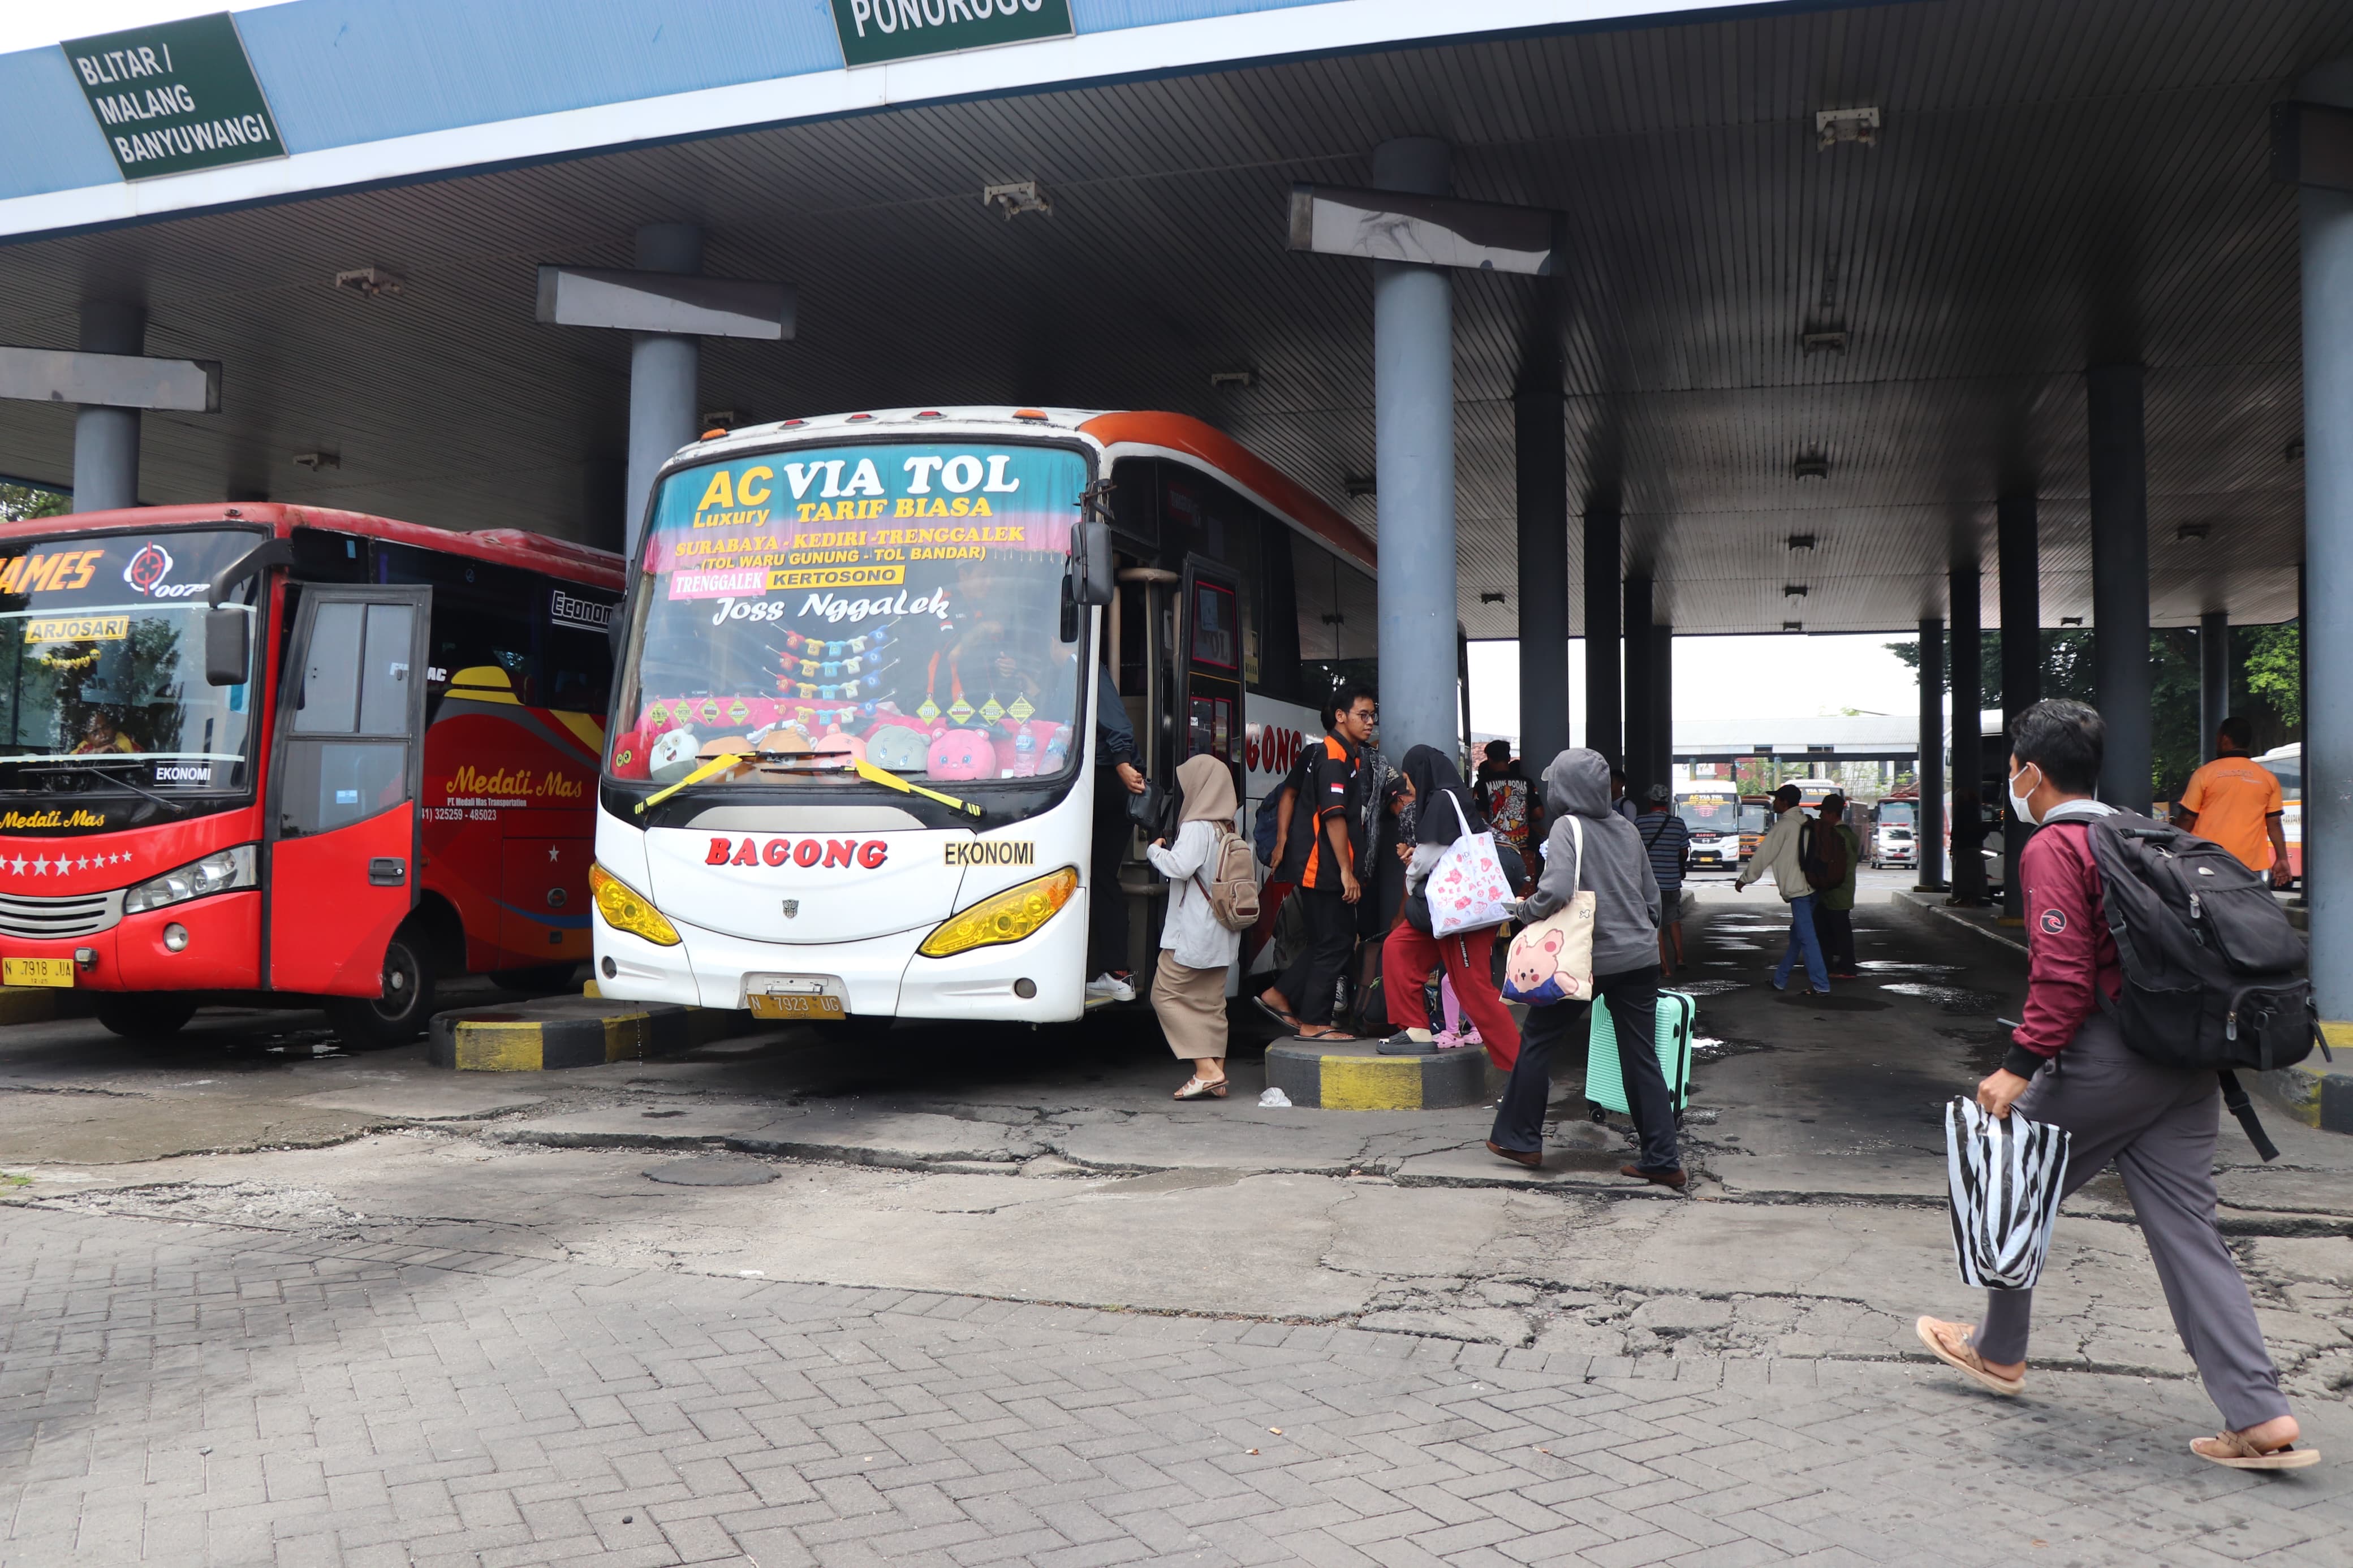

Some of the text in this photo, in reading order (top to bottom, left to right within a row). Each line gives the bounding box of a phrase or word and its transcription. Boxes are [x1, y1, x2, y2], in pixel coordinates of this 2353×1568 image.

[76, 42, 173, 86] BLITAR /
[95, 83, 196, 125] MALANG
[114, 113, 272, 163] BANYUWANGI
[697, 455, 1020, 511] AC VIA TOL
[693, 509, 770, 529] Luxury
[797, 497, 993, 522] TARIF BIASA
[675, 536, 779, 556] SURABAYA
[794, 532, 867, 549] KEDIRI
[701, 557, 734, 573] (TOL
[739, 554, 786, 568] WARU
[789, 549, 859, 565] GUNUNG
[874, 548, 905, 561] TOL
[910, 546, 986, 561] BANDAR)
[0, 550, 104, 594] AMES
[675, 569, 897, 593] TRENGGALEK KERTOSONO
[712, 597, 786, 626] Joss
[30, 620, 124, 639] ARJOSARI
[428, 667, 447, 682] AC
[156, 767, 212, 781] EKONOMI
[446, 765, 582, 798] Medali Mas
[456, 797, 475, 807] Medali
[476, 798, 487, 807] Mas
[488, 798, 527, 807] Transportation
[0, 809, 105, 828] Medali Mas
[435, 808, 463, 821] 325259
[469, 809, 497, 822] 485023
[705, 837, 1035, 869] BAGONG EKONOMI
[5, 961, 71, 976] N 7918 UA
[751, 996, 839, 1012] N 7923 UG
